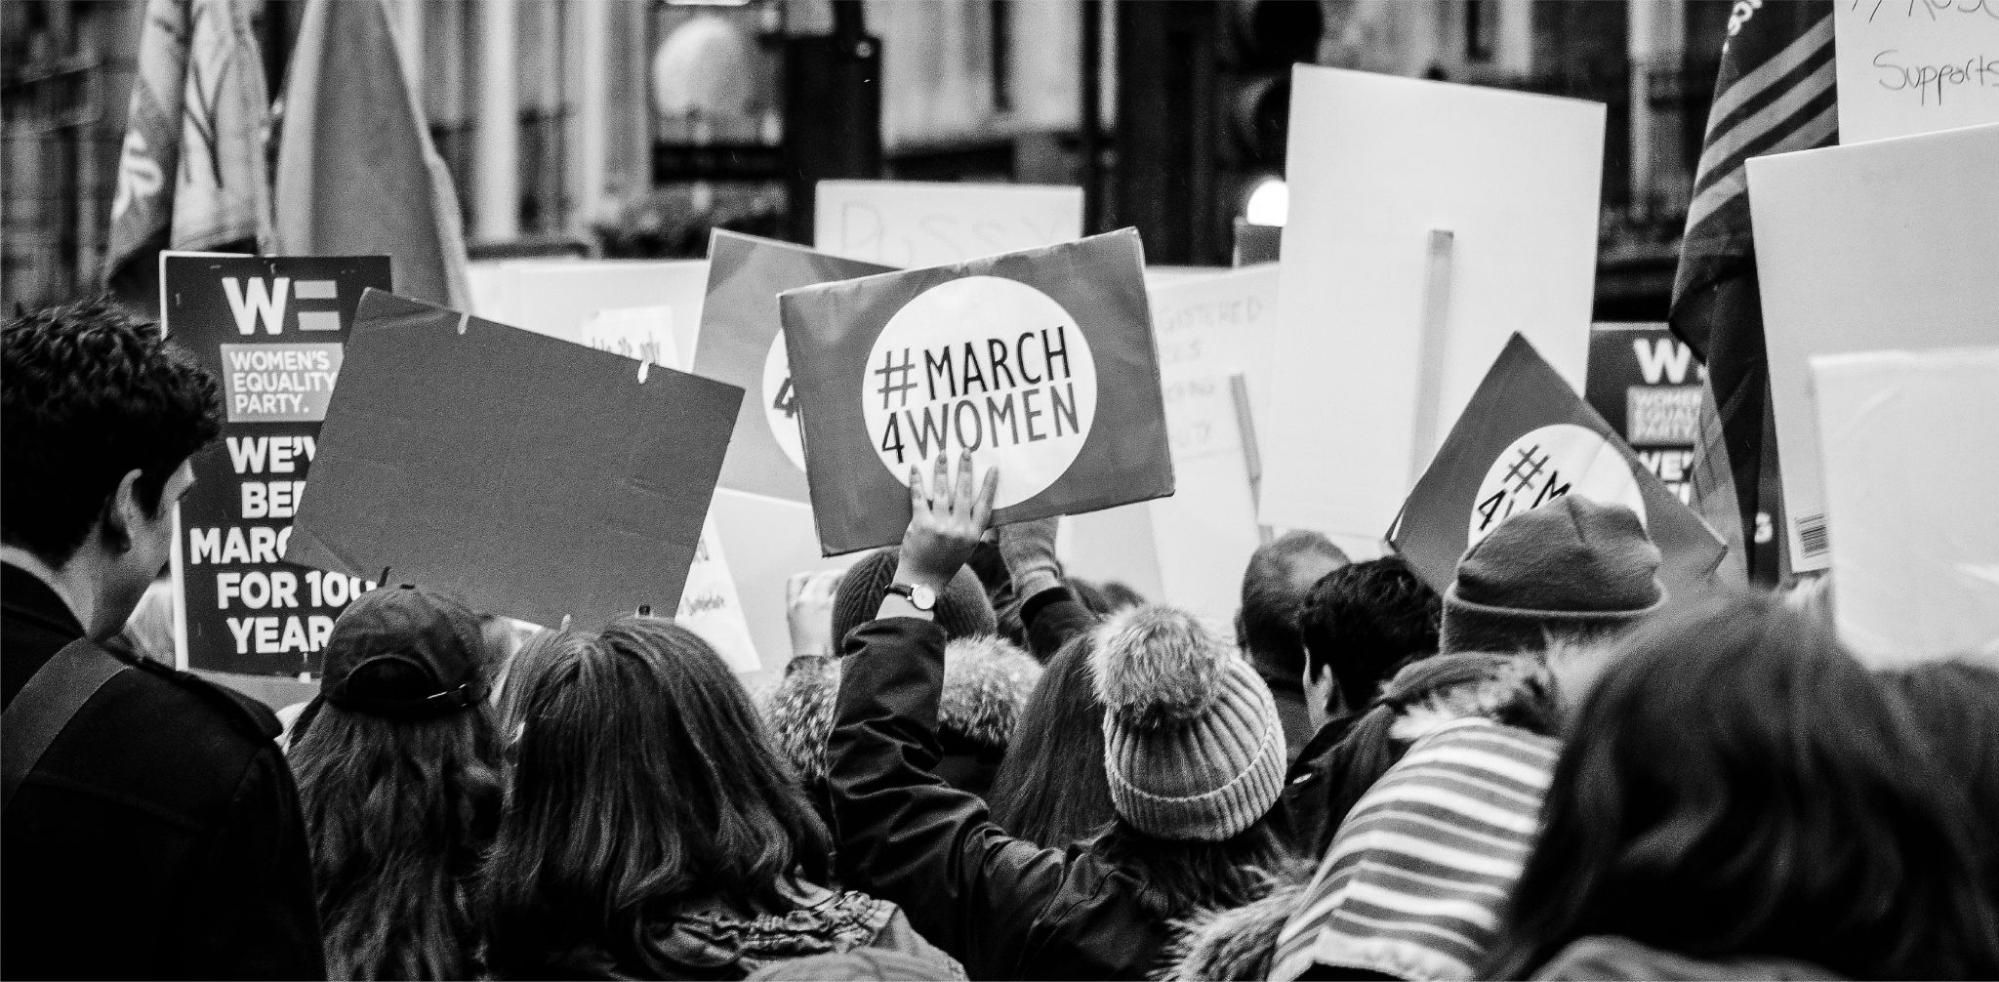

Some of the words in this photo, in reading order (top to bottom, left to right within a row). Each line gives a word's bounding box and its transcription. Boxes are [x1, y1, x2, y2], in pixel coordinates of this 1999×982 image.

[229, 350, 330, 371] WOMEN'S
[874, 325, 1071, 410] #MARCH
[232, 371, 338, 394] EQUALITY
[235, 393, 310, 414] PARTY.
[881, 382, 1080, 464] 4WOMEN
[217, 571, 299, 609] FOR
